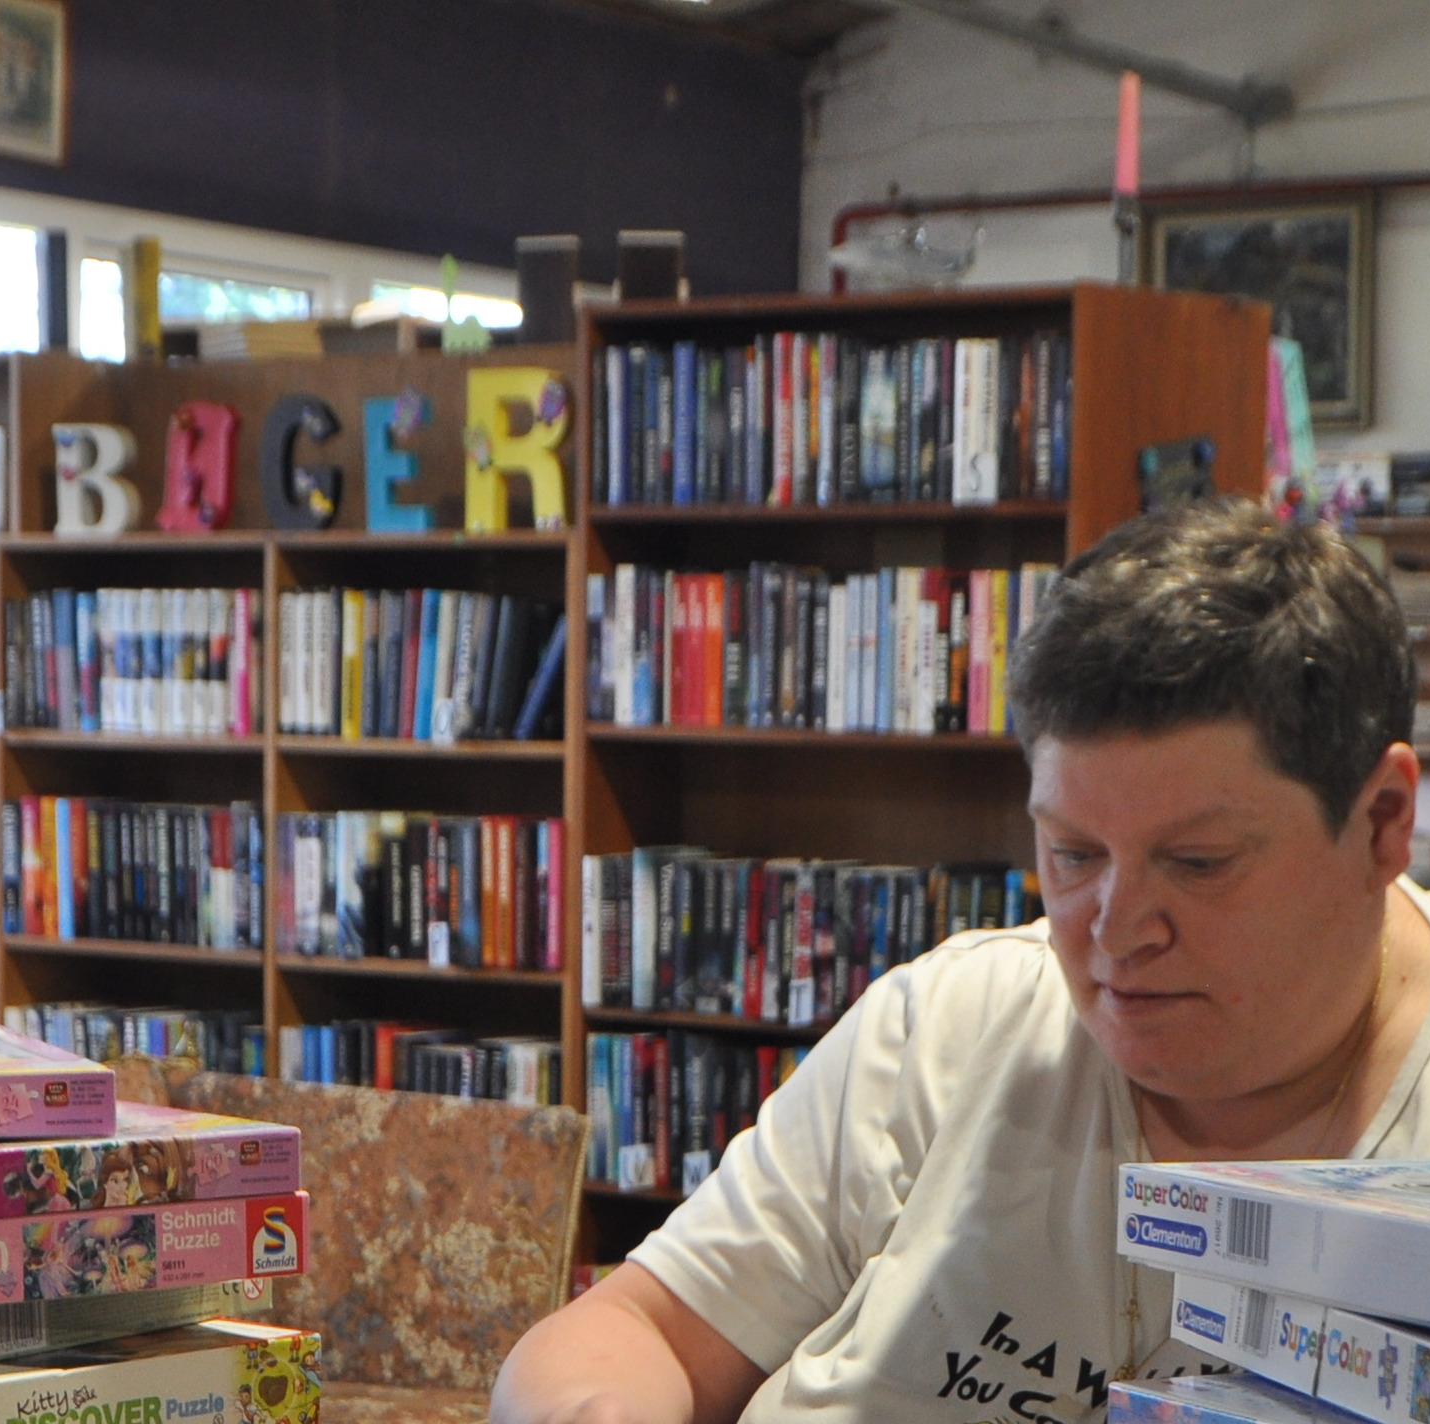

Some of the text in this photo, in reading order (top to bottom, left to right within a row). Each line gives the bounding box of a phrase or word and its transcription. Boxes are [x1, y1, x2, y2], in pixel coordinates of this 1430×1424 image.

[1125, 1175, 1210, 1214] Super Color
[161, 1206, 237, 1231] Schmidt
[161, 1230, 222, 1253] Puzzle
[1140, 1218, 1204, 1253] Clementoni
[254, 1254, 297, 1271] Schmidt
[981, 1311, 1021, 1356] In
[1021, 1340, 1057, 1378] A
[1278, 1311, 1327, 1361] Super
[1326, 1327, 1373, 1380] Color
[937, 1351, 1005, 1405] You
[15, 1389, 70, 1420] Kitty
[165, 1391, 226, 1421] Puzzle
